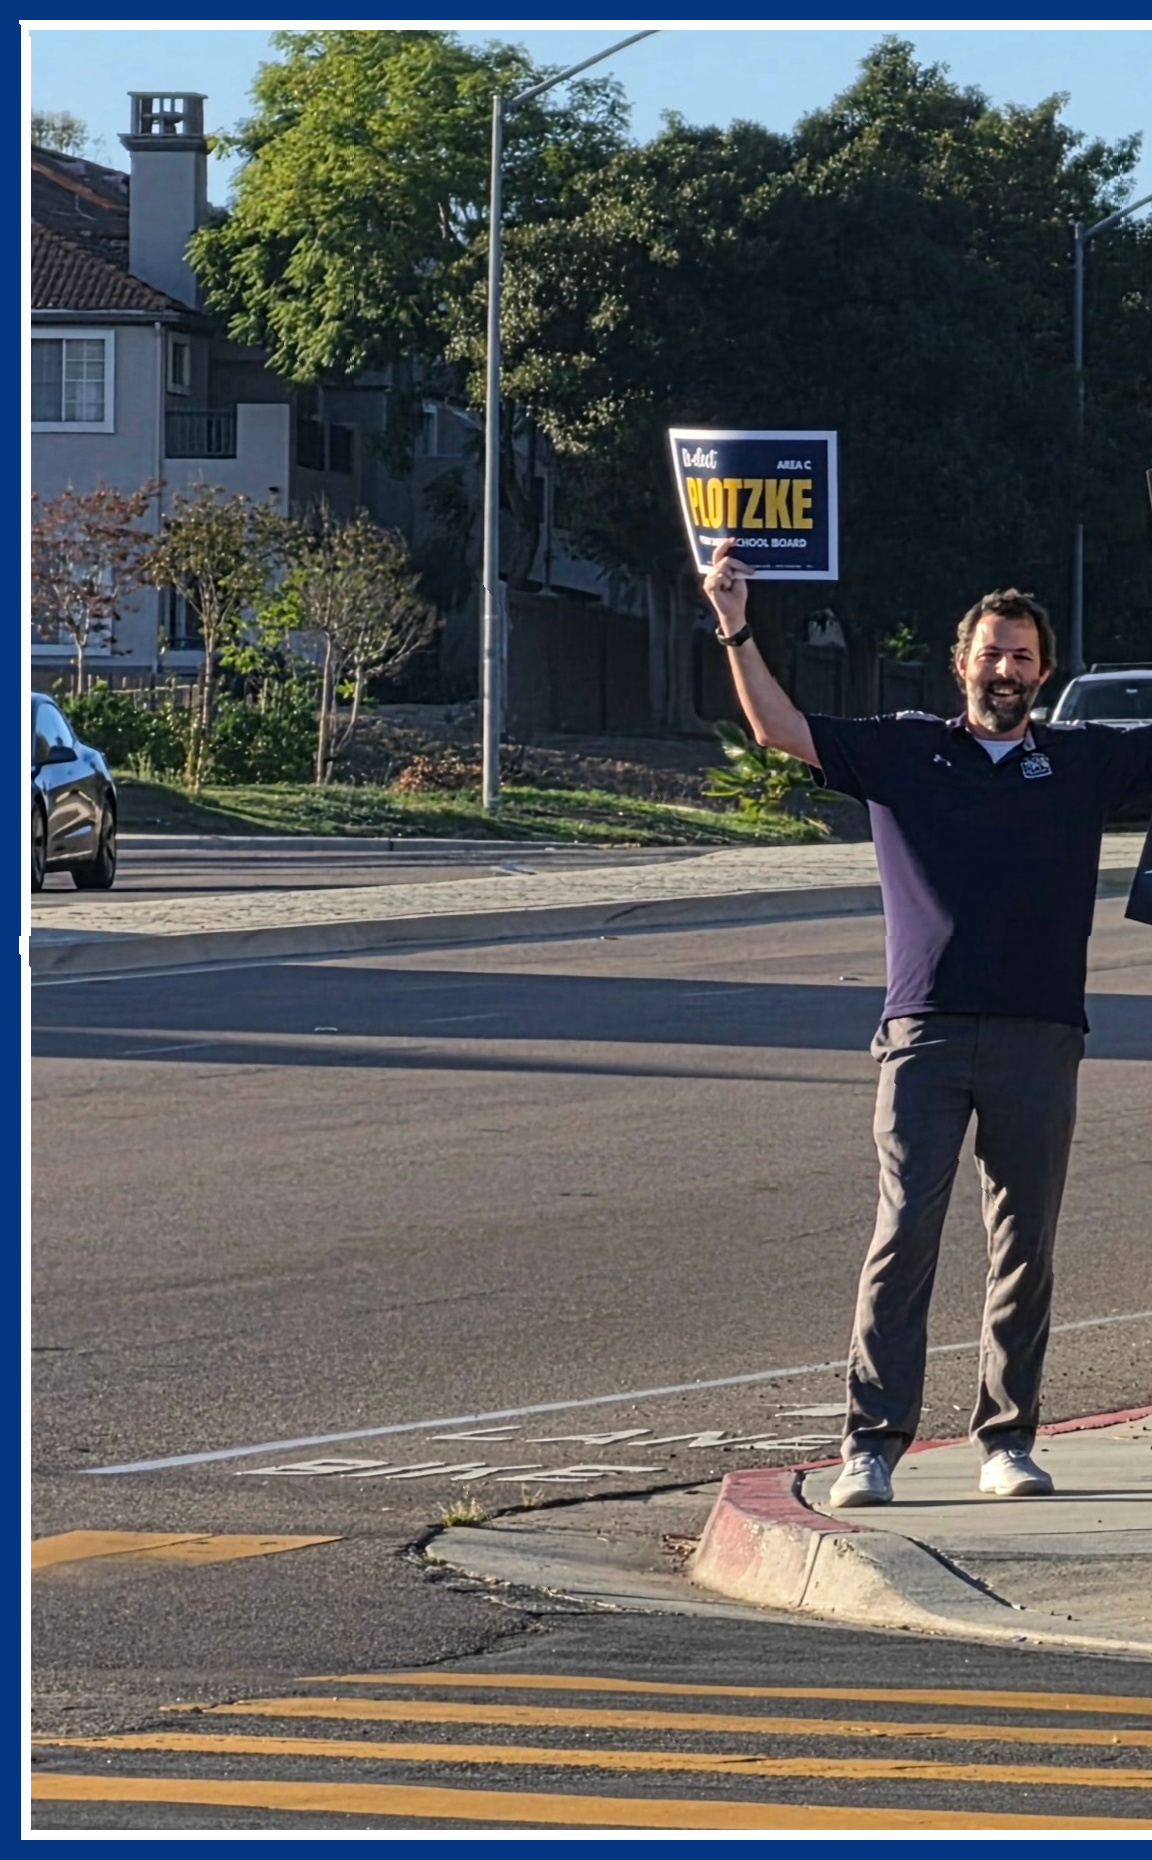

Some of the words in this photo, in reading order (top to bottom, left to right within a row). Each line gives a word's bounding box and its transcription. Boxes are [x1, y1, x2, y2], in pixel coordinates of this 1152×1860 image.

[777, 460, 803, 470] AREA
[804, 460, 812, 470] C
[686, 477, 814, 530] PLOTZKE
[735, 537, 769, 548] CHOOL
[771, 538, 808, 548] BOARD
[234, 1458, 667, 1483] BIKE
